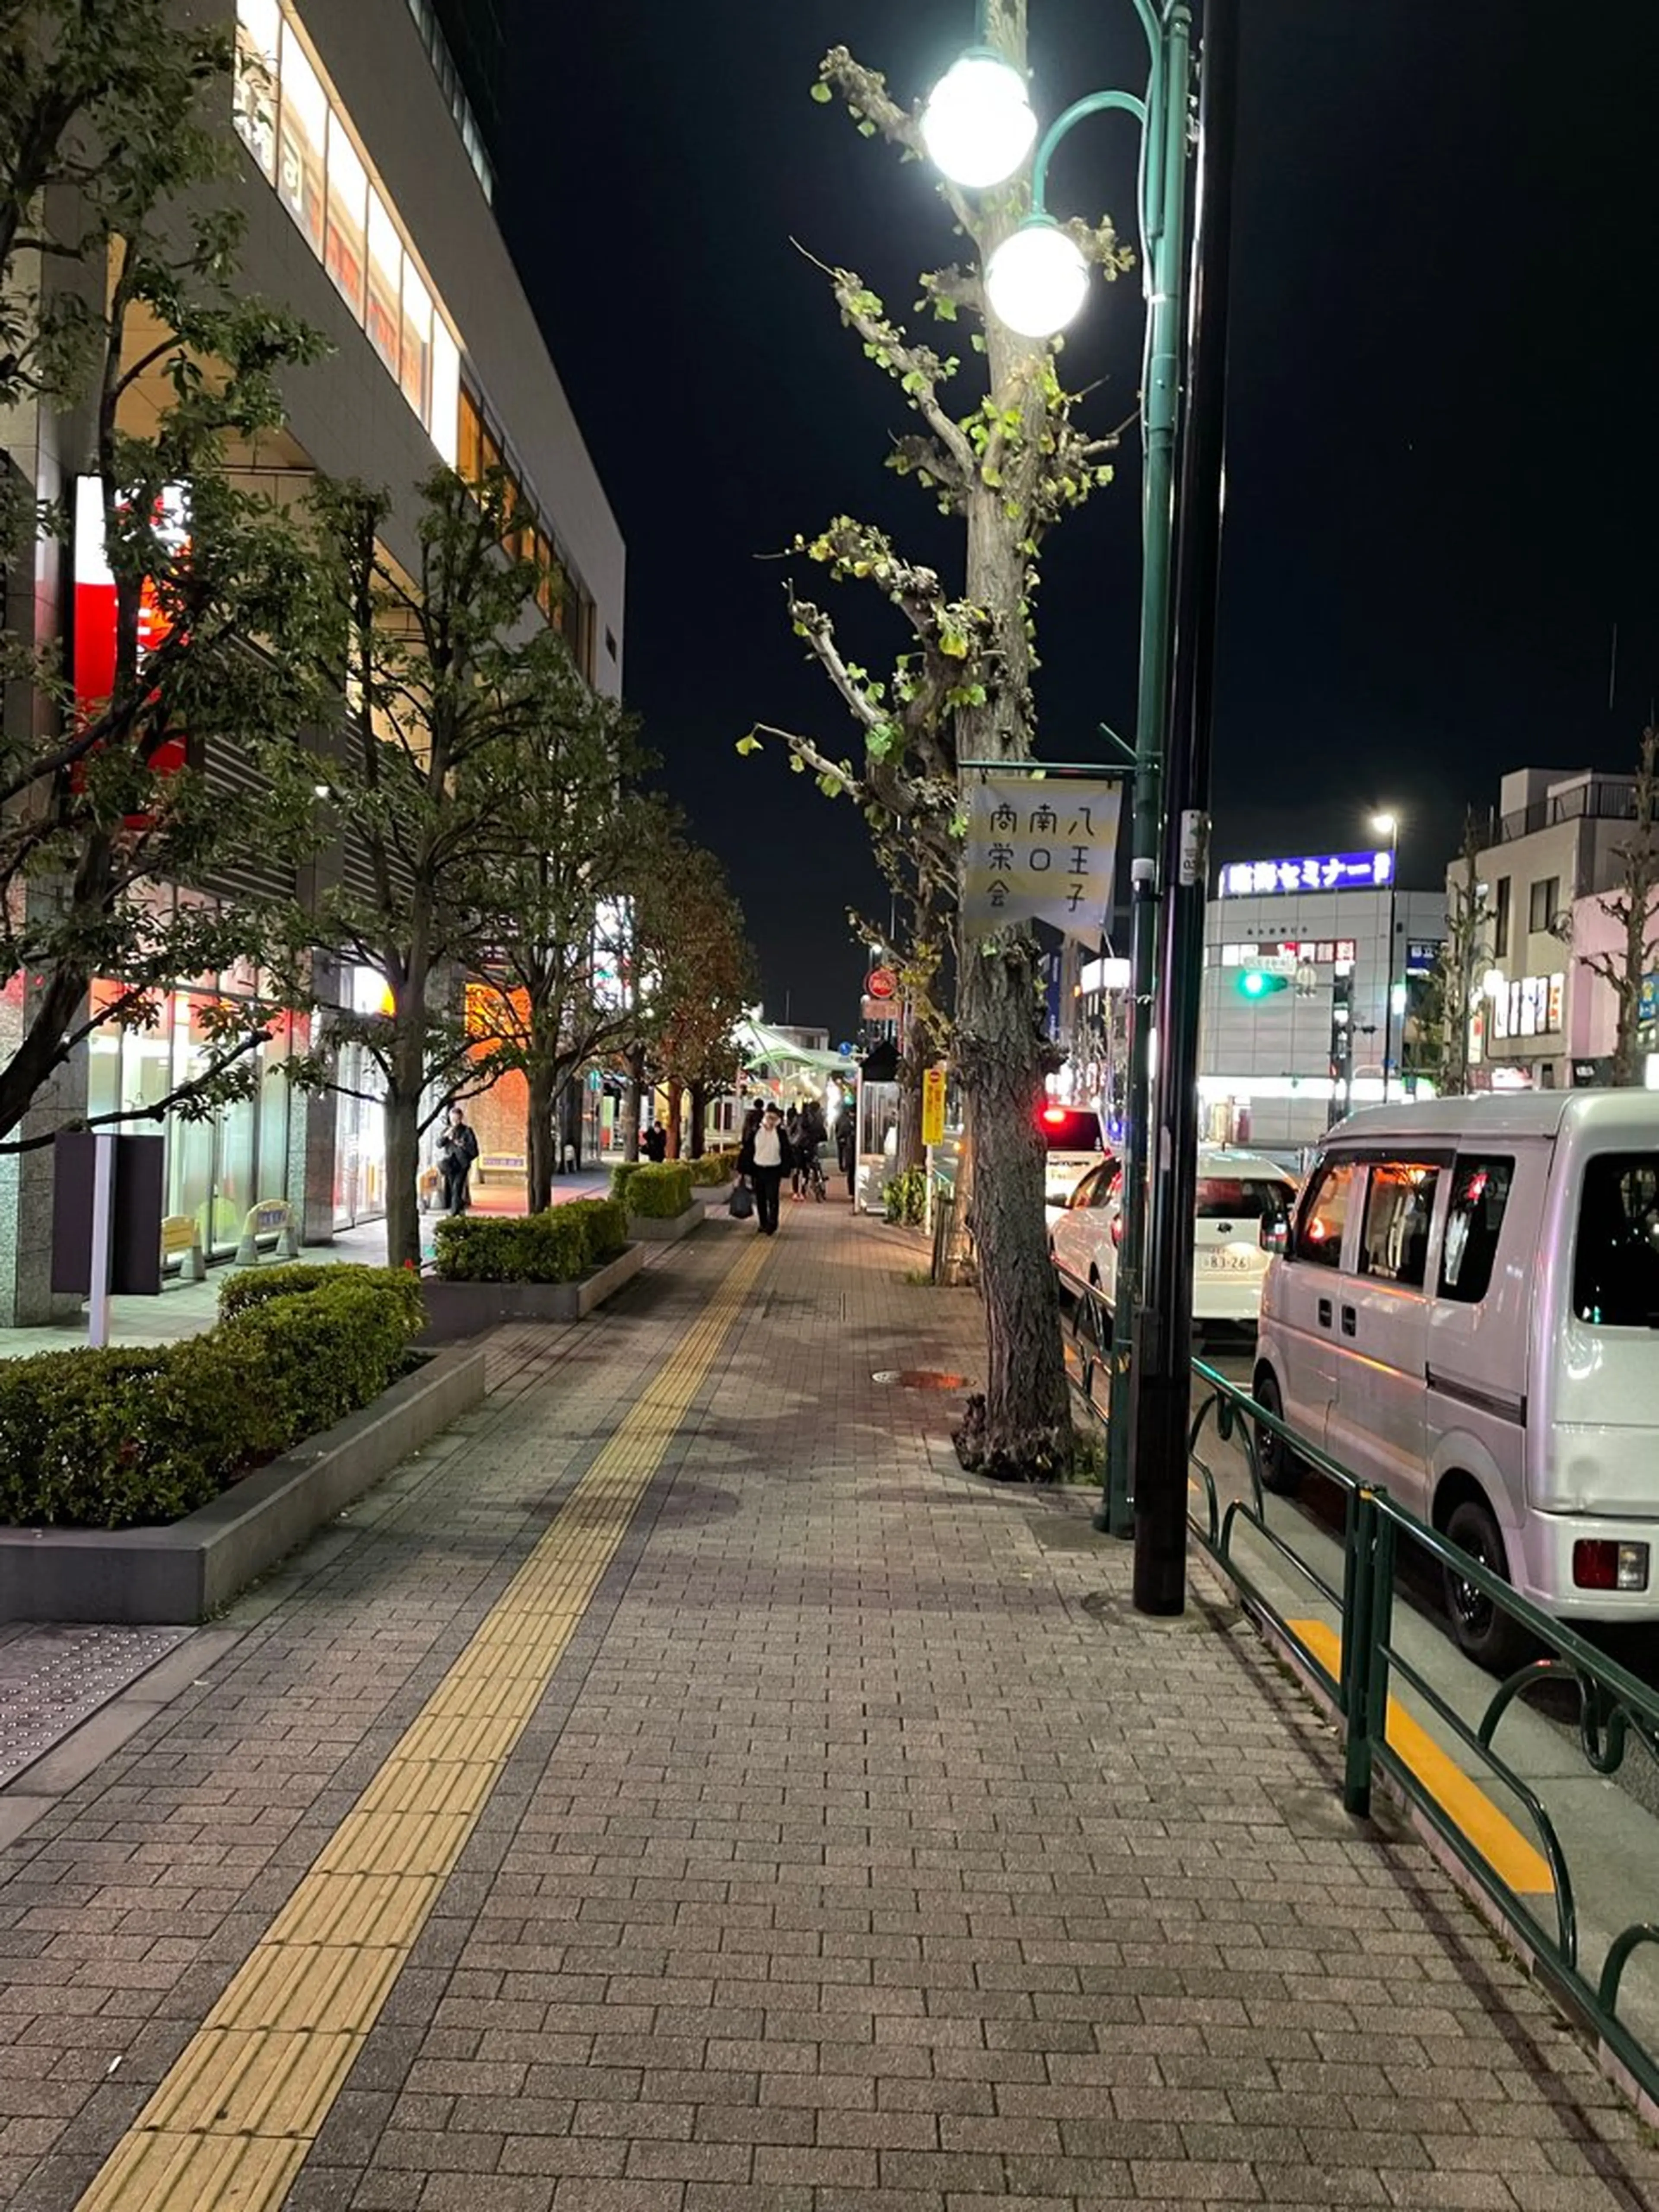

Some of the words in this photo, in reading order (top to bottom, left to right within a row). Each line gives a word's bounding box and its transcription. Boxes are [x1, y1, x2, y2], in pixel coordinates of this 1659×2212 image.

[987, 802, 1017, 907] 商栄会
[1066, 807, 1094, 912] 八王子
[1230, 858, 1371, 893] セミナー
